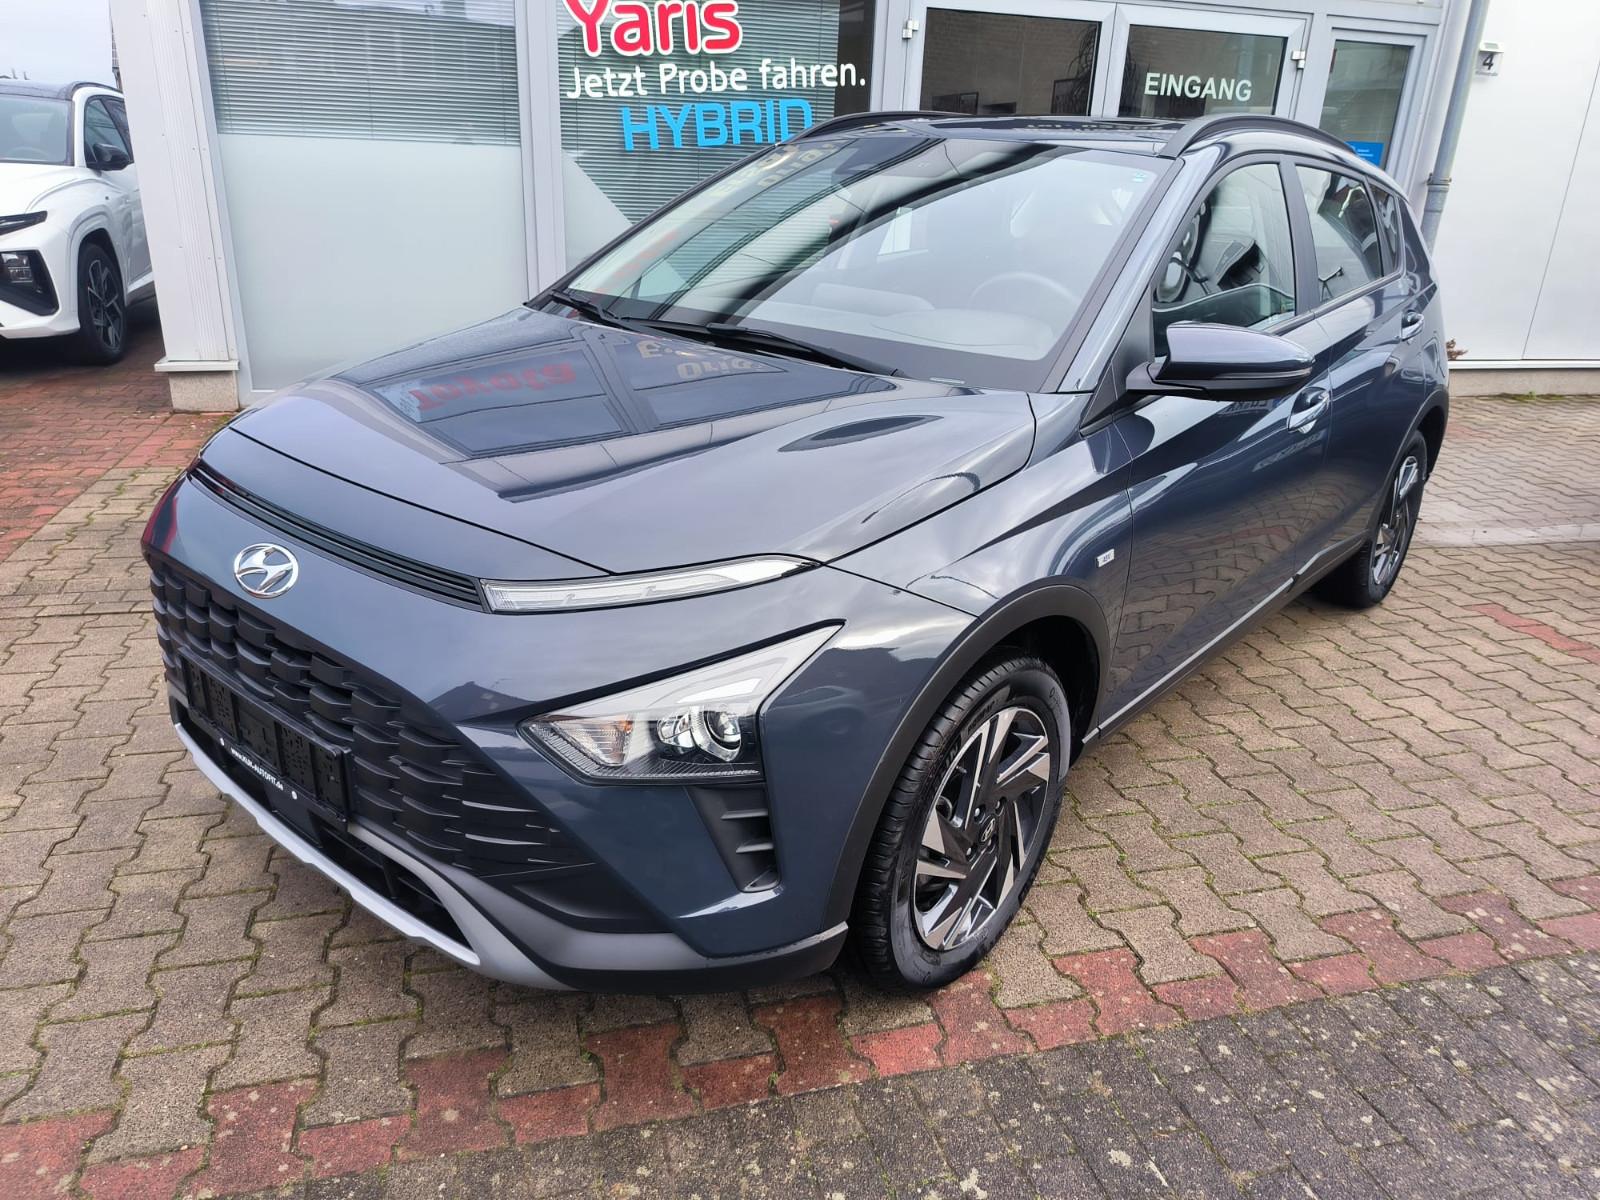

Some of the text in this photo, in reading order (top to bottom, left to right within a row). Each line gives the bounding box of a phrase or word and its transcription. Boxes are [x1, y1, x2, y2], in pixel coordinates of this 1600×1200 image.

[565, 0, 743, 56] Yaris
[566, 57, 866, 99] Jetzt Probe fahren.
[1482, 53, 1494, 70] 4
[1144, 72, 1253, 102] EINGANG
[620, 98, 814, 151] HYBRID
